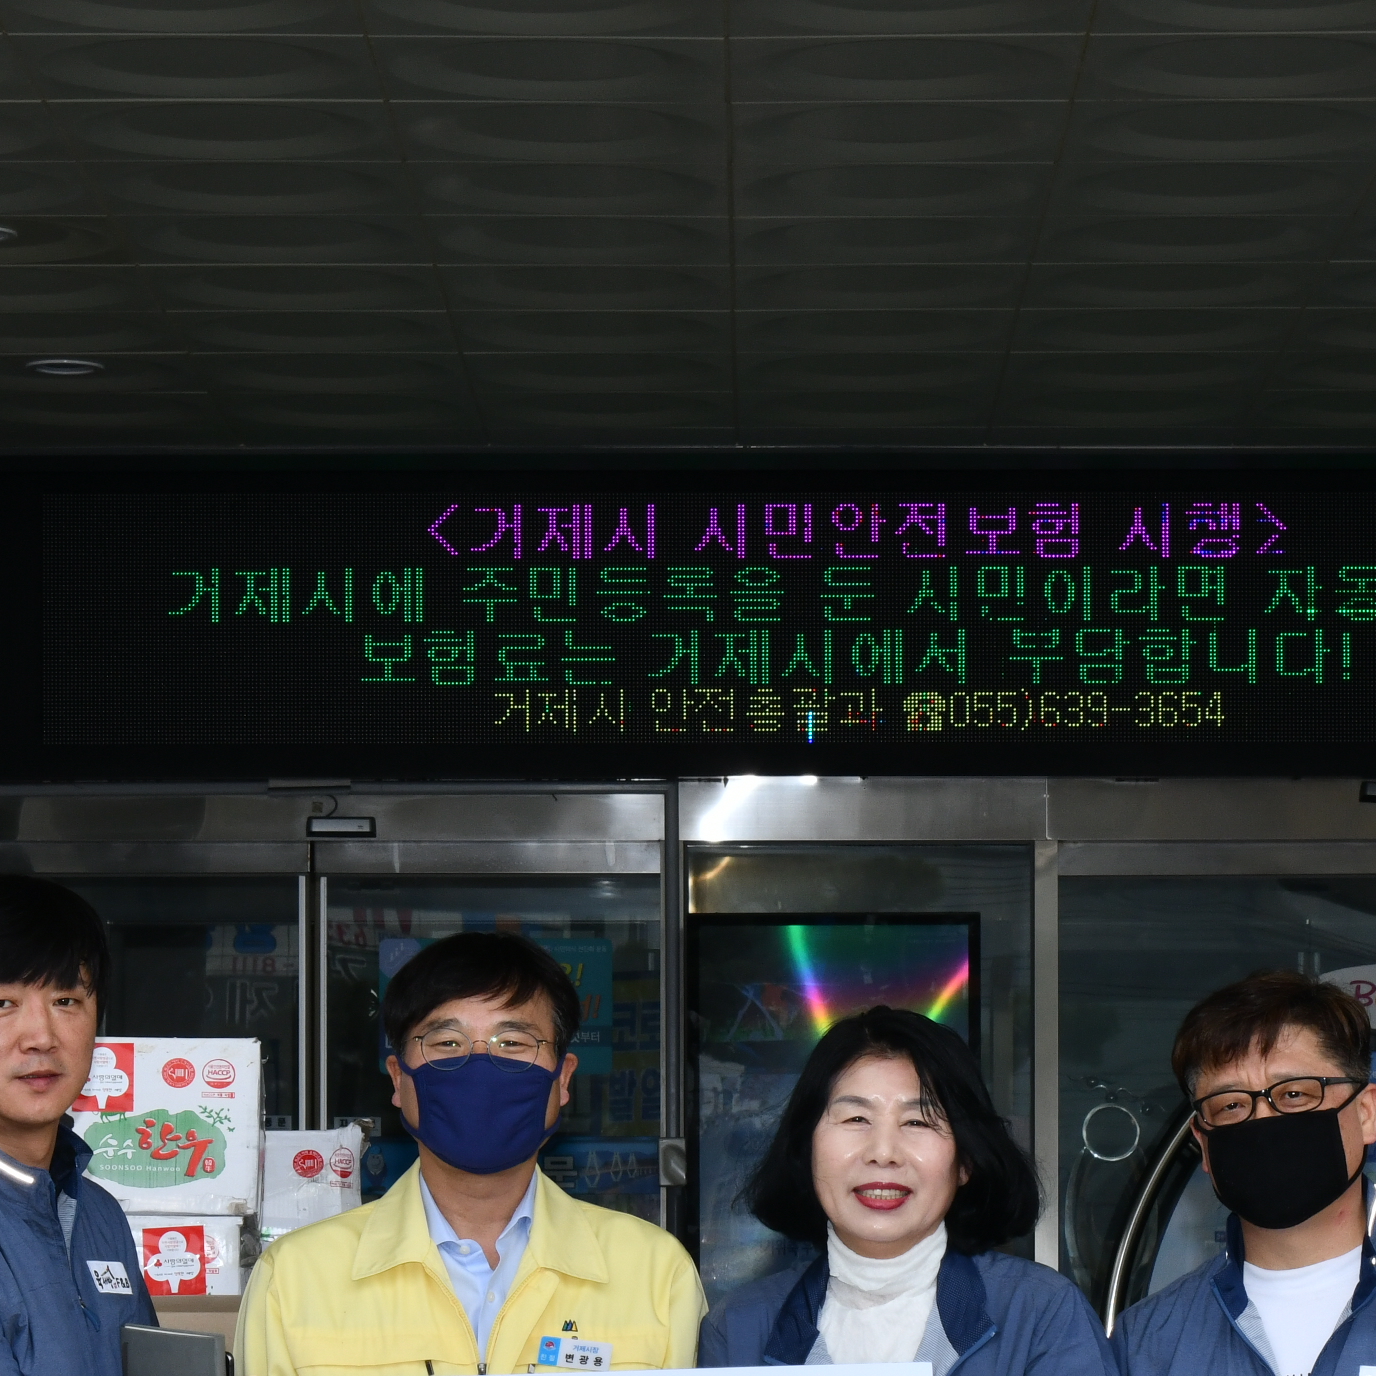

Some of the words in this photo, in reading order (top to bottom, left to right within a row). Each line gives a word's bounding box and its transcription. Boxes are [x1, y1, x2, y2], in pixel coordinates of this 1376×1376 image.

[694, 503, 1081, 560] 시민안전보험
[169, 567, 424, 622] 거제시에
[463, 567, 785, 622] 주민등록을
[820, 566, 872, 622] 둔
[907, 566, 1224, 621] 시민이라면
[361, 630, 616, 685] 보험료는
[648, 630, 966, 684] 거제시에서
[1009, 629, 1351, 684] 부담합니다!
[494, 688, 625, 732] 거제시
